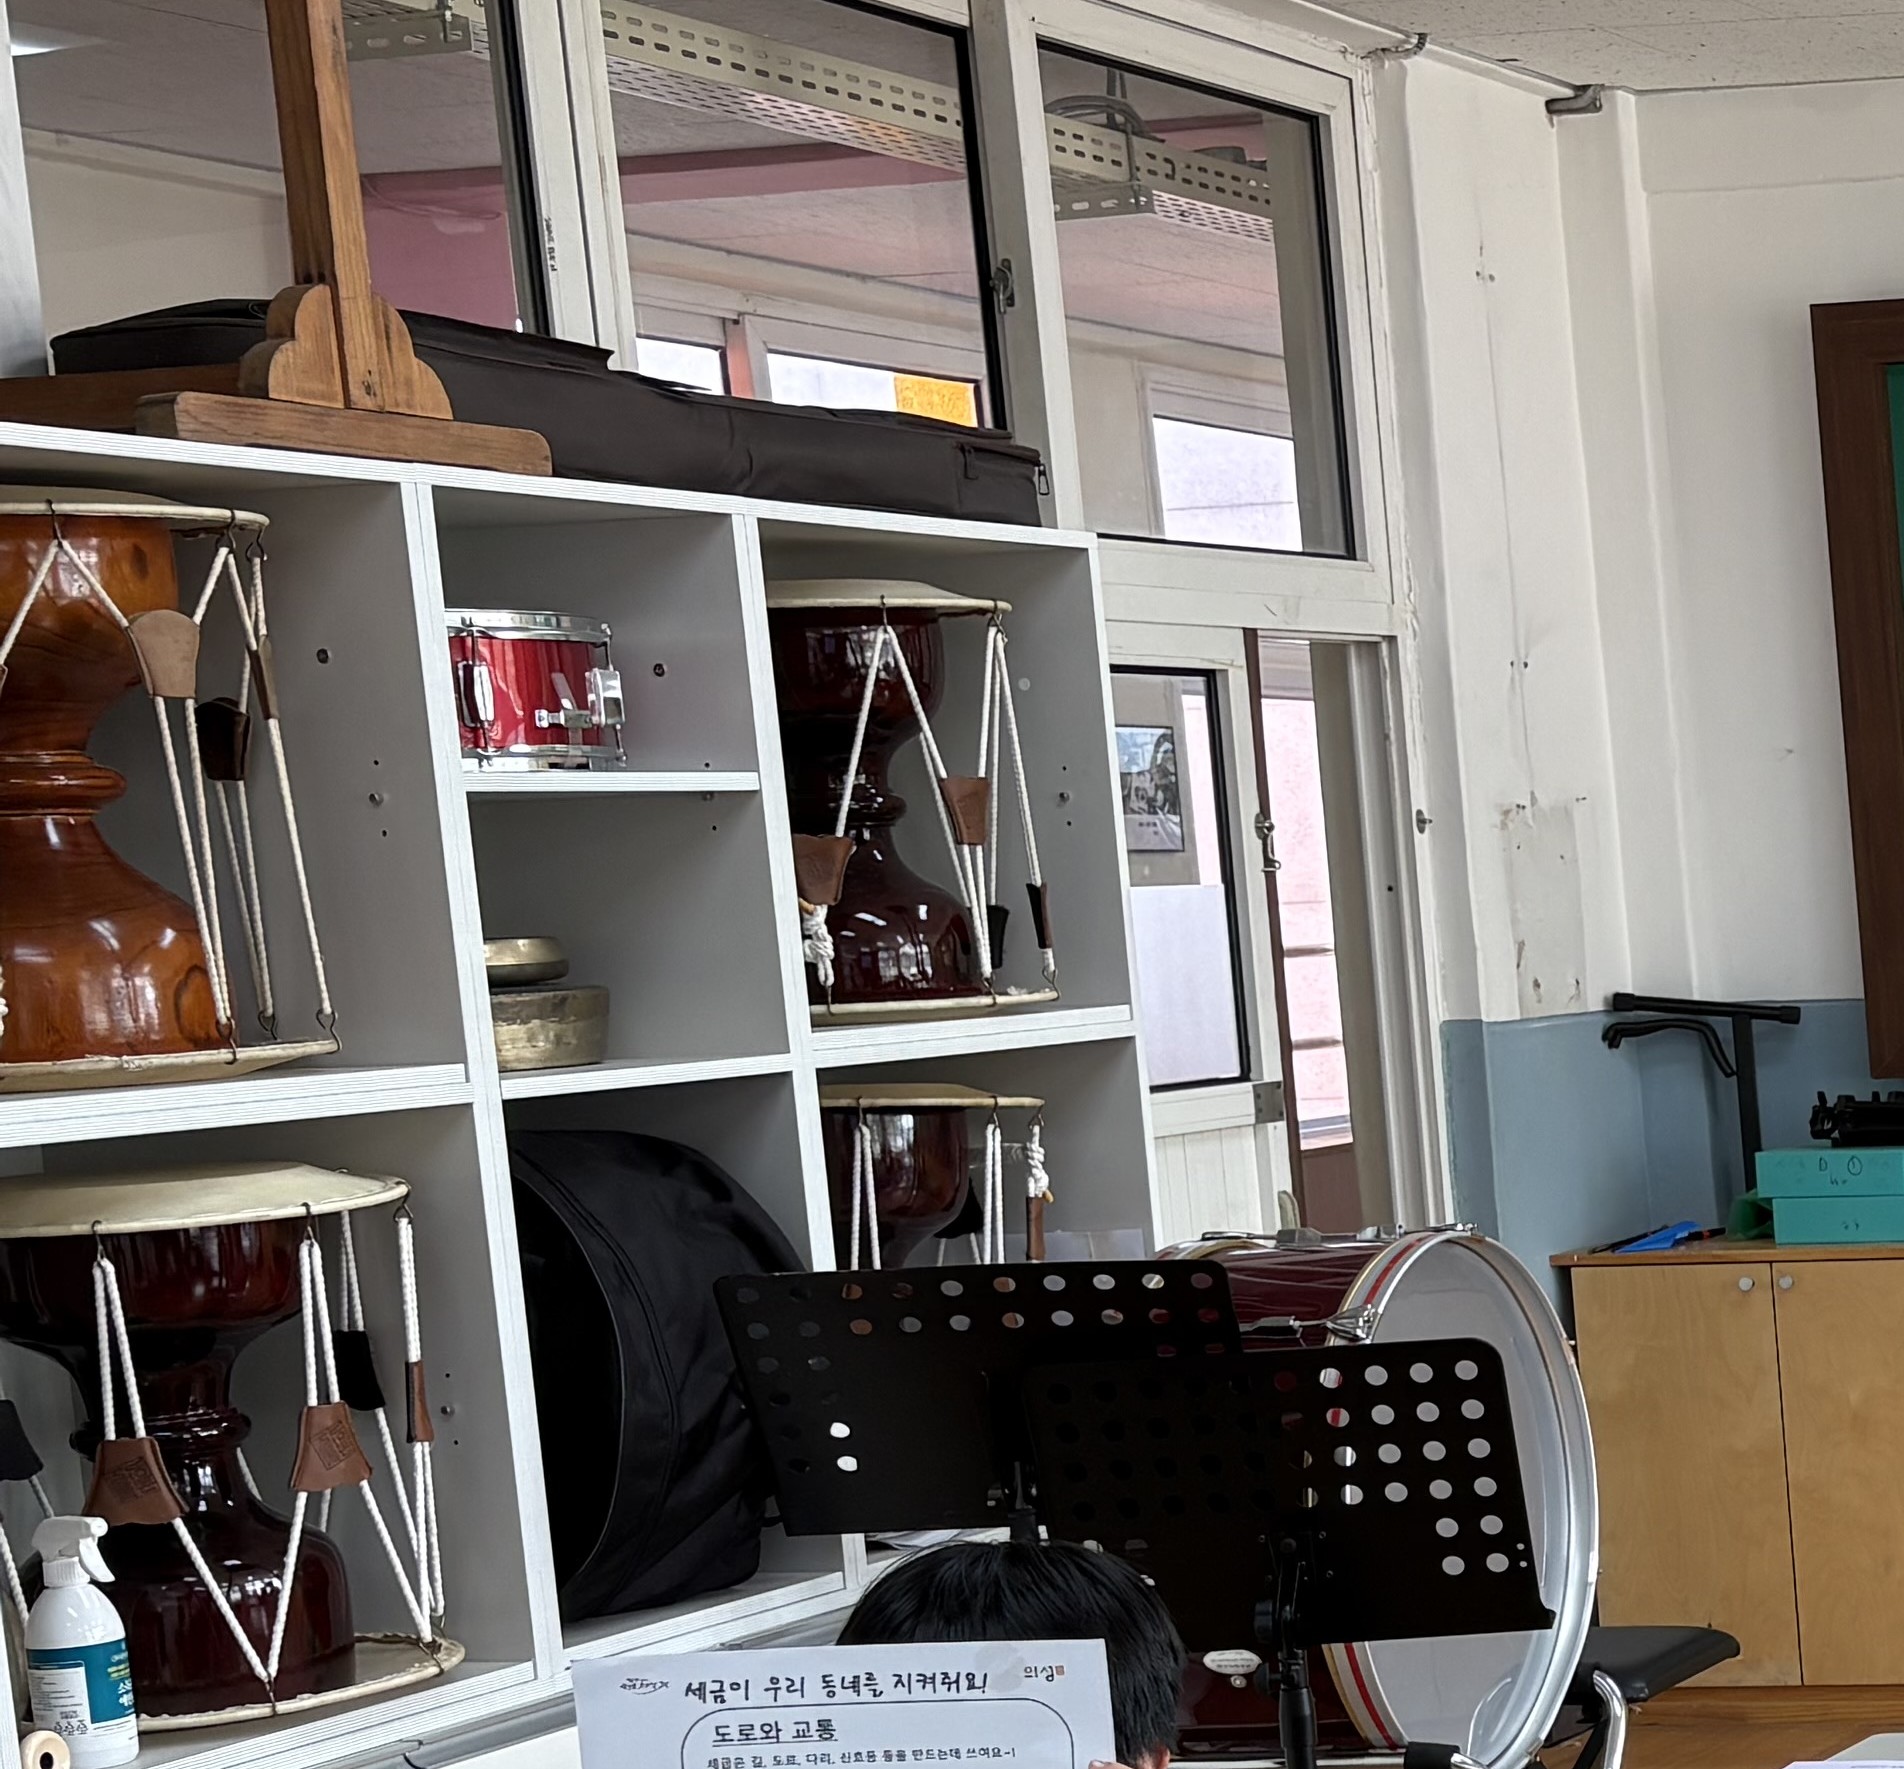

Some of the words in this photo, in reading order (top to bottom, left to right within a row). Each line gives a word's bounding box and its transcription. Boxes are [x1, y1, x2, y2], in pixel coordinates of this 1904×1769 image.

[1024, 1665, 1054, 1682] 의성
[684, 1676, 752, 1706] 세금이
[763, 1675, 807, 1701] 우리
[820, 1672, 884, 1700] 동네를
[713, 1721, 782, 1743] 도로와
[792, 1719, 837, 1741] 교통
[707, 1757, 745, 1769] 세금은
